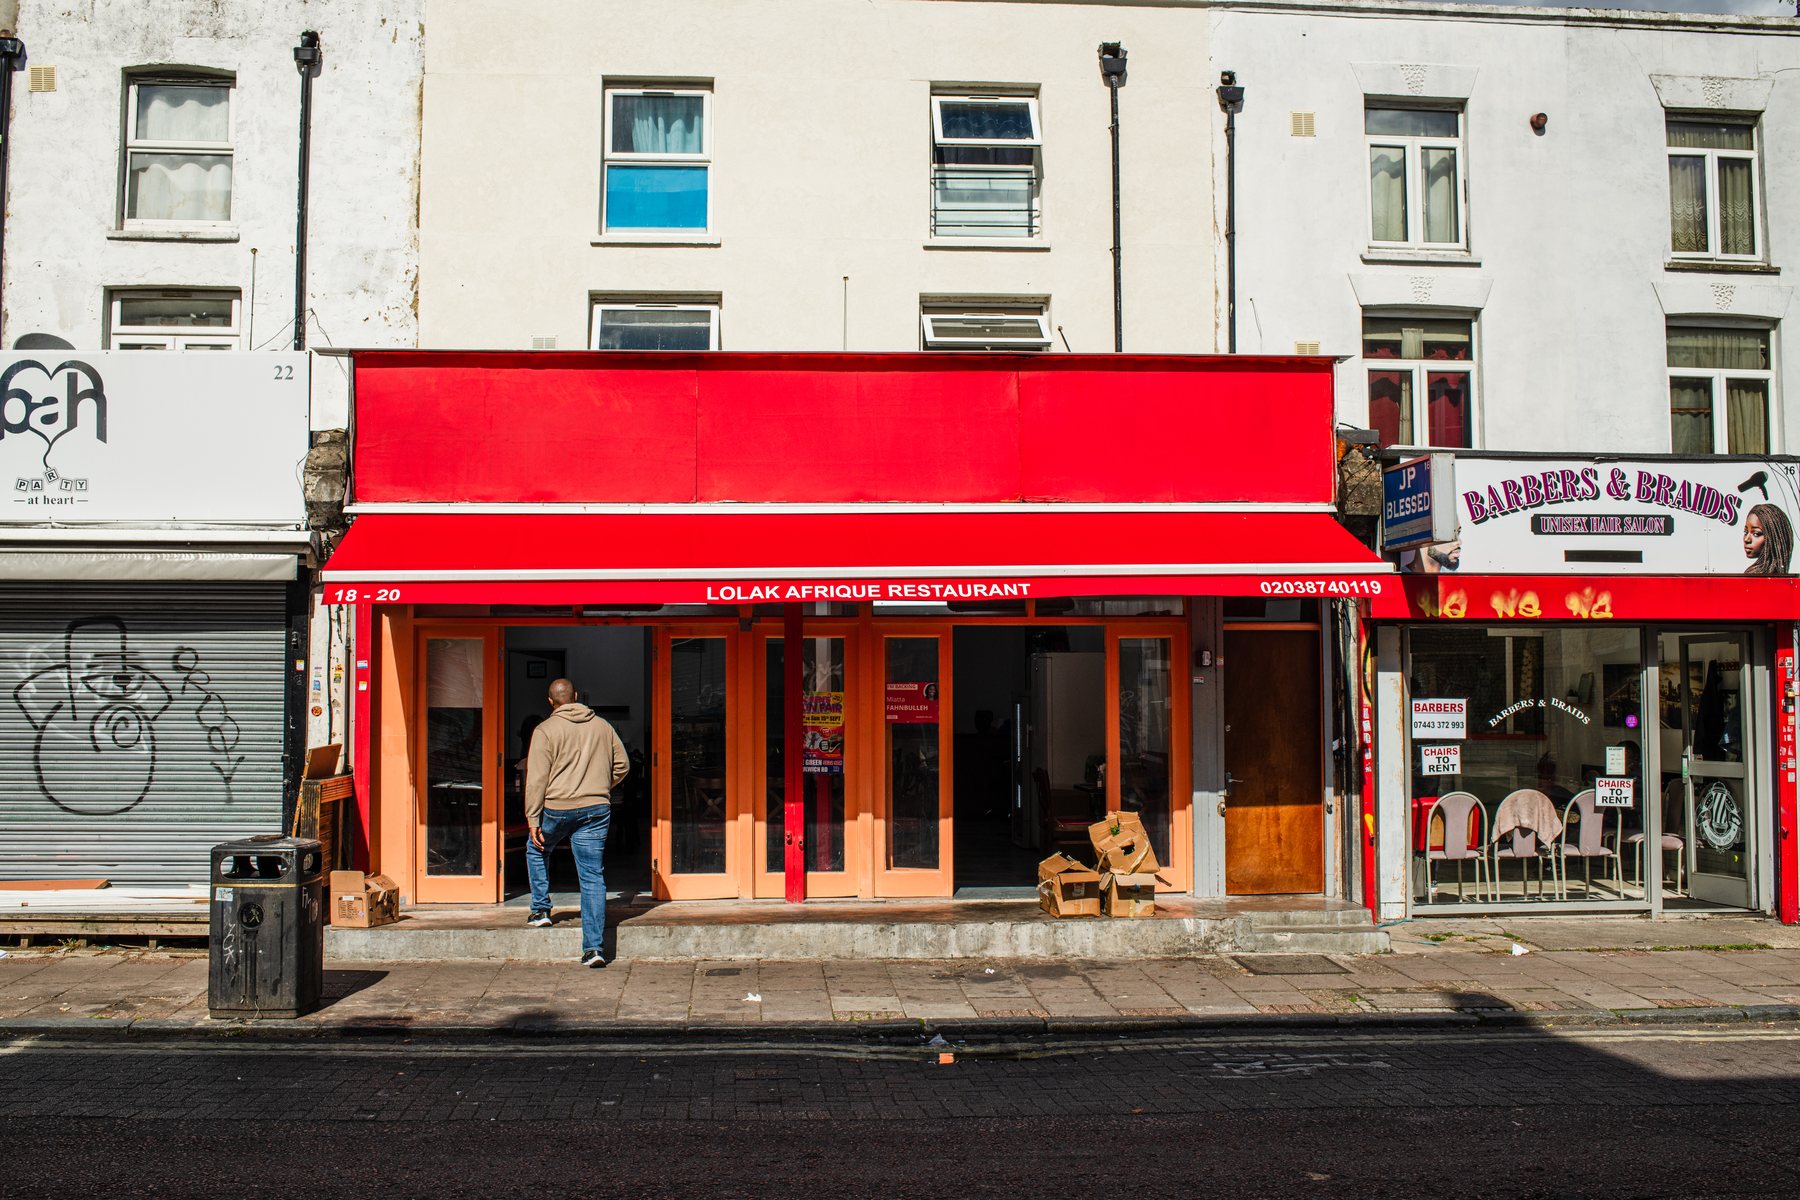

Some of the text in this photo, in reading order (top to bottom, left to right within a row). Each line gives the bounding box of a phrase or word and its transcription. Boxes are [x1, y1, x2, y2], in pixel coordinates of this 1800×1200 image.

[274, 365, 294, 380] 22
[1424, 462, 1430, 470] 16
[1784, 465, 1796, 476] 16
[16, 468, 88, 491] PARTY
[1399, 466, 1416, 490] JP
[28, 495, 74, 505] at heart
[1462, 467, 1743, 526] BARBERS & BRAIDS
[1387, 491, 1430, 519] BLESSED
[1540, 516, 1664, 534] UNISEX HAIR SALON
[706, 583, 1031, 601] LOLAK AFRIQUE RESTAURANT
[1260, 580, 1382, 595] 02038740119
[334, 589, 357, 602] 18
[376, 588, 401, 602] 20
[1414, 703, 1464, 713] BARBERS
[1488, 697, 1591, 728] BARBERS & BRAIDS
[1413, 721, 1465, 729] 07443 372 993
[1423, 747, 1458, 757] CHAIRS
[1435, 756, 1450, 764] TO
[1428, 763, 1457, 773] RENT
[1597, 780, 1632, 788] CHAIRS
[1608, 788, 1623, 796] TO
[1601, 795, 1629, 804] RENT
